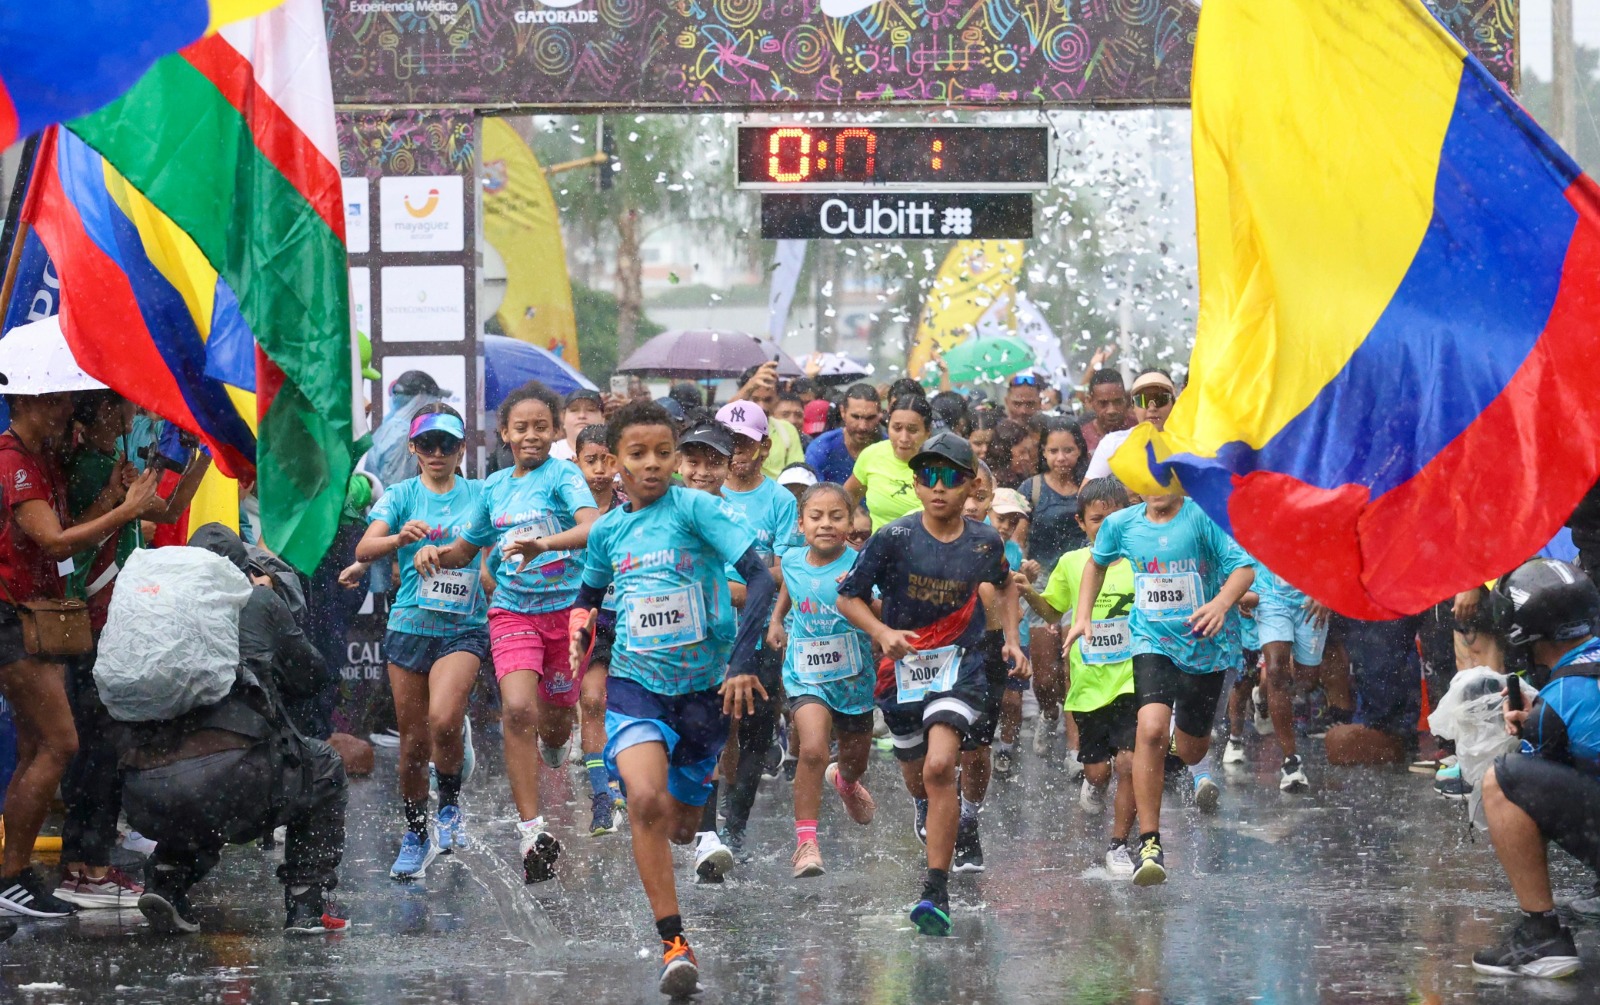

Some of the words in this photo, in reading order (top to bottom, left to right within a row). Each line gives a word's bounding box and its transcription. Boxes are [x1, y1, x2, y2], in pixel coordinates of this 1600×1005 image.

[350, 1, 414, 14] Experiencia
[416, 0, 458, 12] Médica
[440, 14, 458, 25] IPS
[514, 10, 598, 23] GATORADE
[819, 199, 935, 235] Cubitt
[891, 526, 911, 536] 2FIT
[642, 549, 675, 568] RUN
[1134, 556, 1168, 574] kids
[1169, 558, 1197, 573] RUN
[432, 581, 467, 596] 21652
[1147, 590, 1183, 602] 20833
[640, 610, 680, 628] 20712
[1091, 633, 1123, 647] 22502
[347, 641, 384, 664] CAL
[807, 651, 840, 666] 20128
